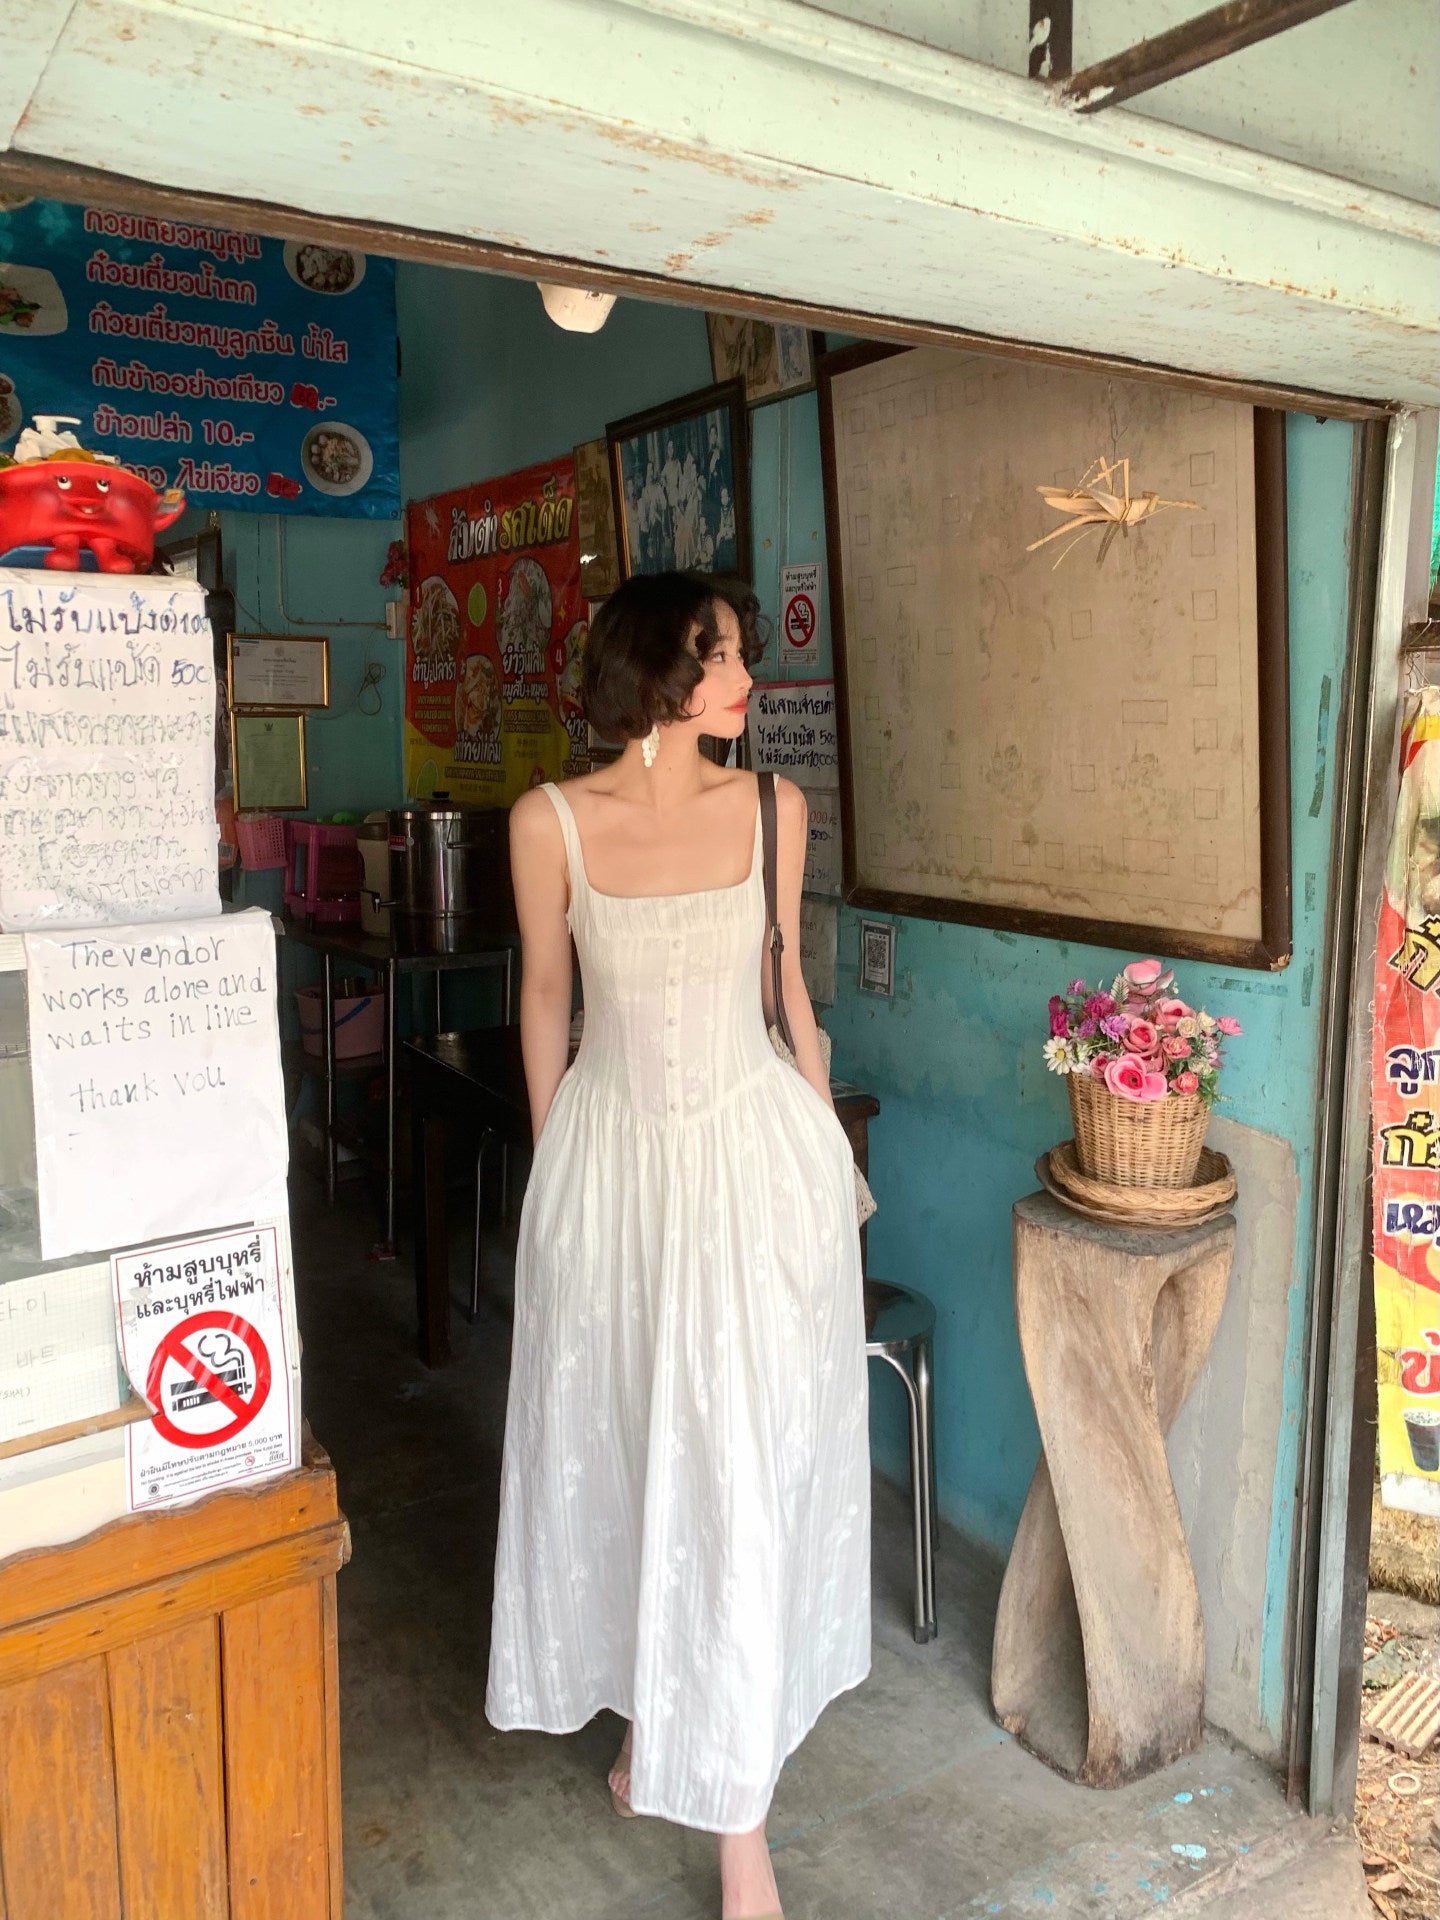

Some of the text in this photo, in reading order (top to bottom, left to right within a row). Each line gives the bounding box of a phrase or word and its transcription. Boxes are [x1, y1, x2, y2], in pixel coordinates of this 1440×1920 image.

[87, 250, 256, 304] ก๋วยเตี๋ยวน้ำตก
[90, 302, 348, 362] ก๋วยเตี๋ยวหมูลูกชิ้น น้ำใส
[93, 358, 284, 404] กับข้าวอย่างเดียว
[93, 404, 254, 446] ข้าวเปล่า 10.-
[556, 649, 563, 666] 4
[43, 967, 267, 1012] works alone and
[48, 1004, 257, 1050] waits in line
[70, 1072, 158, 1112] thank
[134, 1234, 262, 1287] ห้ามสูบบุหรี่
[136, 1272, 265, 1319] และบุหรี่ไฟฟ้า
